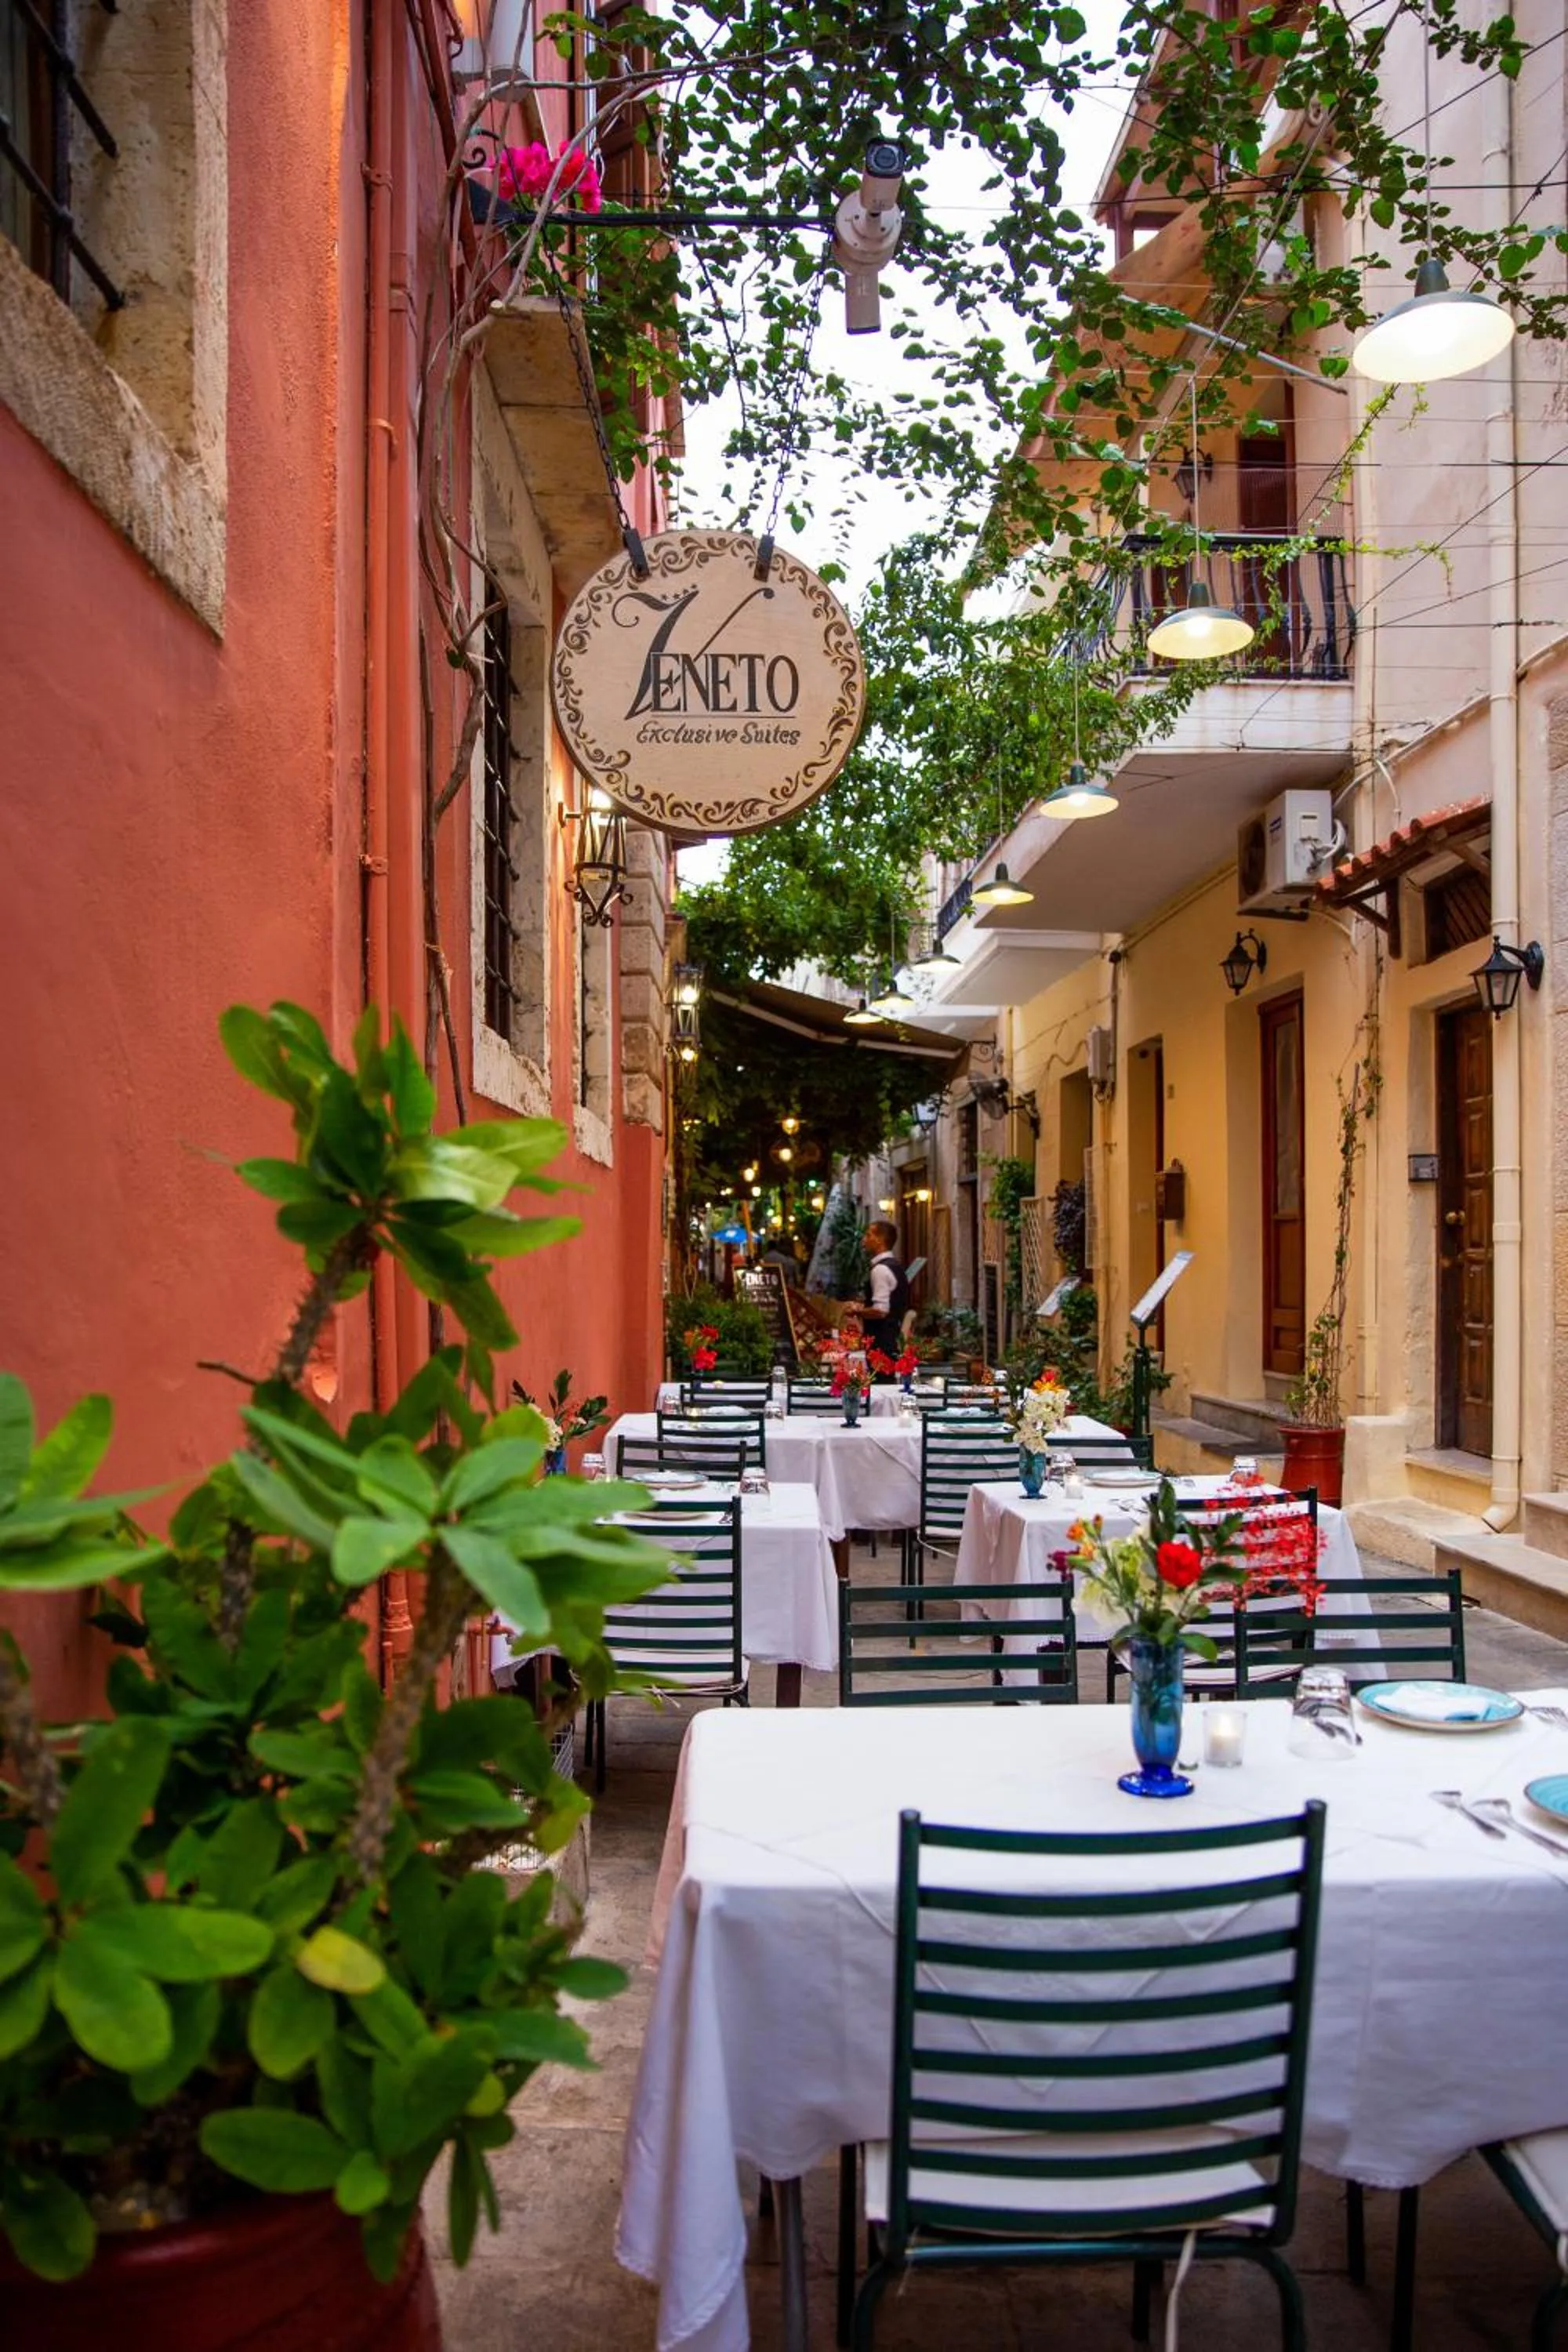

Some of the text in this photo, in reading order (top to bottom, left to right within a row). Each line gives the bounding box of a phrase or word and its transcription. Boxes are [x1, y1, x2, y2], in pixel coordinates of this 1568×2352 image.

[612, 587, 799, 720] VENETO
[636, 720, 800, 746] Exclusive Suites
